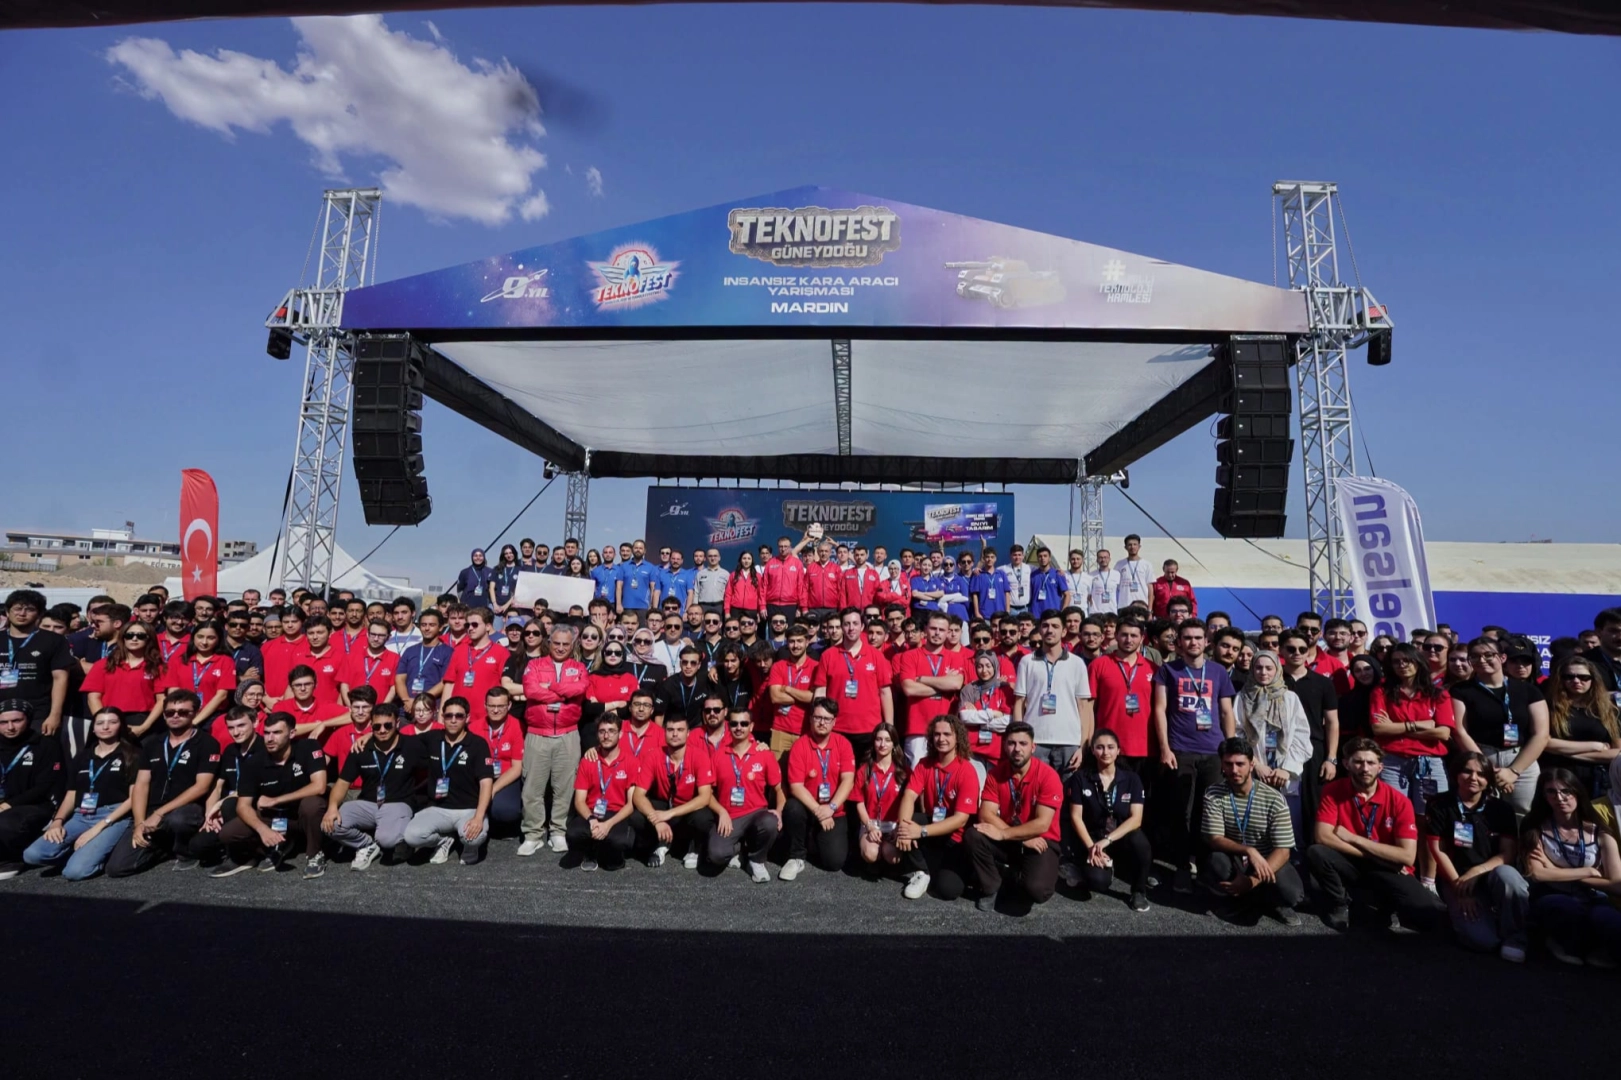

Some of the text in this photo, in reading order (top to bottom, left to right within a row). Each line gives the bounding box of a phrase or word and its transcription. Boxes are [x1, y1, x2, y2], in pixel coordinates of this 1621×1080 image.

[736, 214, 896, 244] TEKNOFEST
[771, 243, 868, 259] GÜNEYDOĞU
[597, 272, 672, 302] TEKNOFEST
[723, 277, 899, 286] INSANSIZ KARA ARACI
[767, 287, 854, 296] YARIŞMASI
[771, 302, 849, 313] MARDIN
[787, 504, 874, 521] TEKNOFEST
[710, 525, 755, 543] TEKNOFEST
